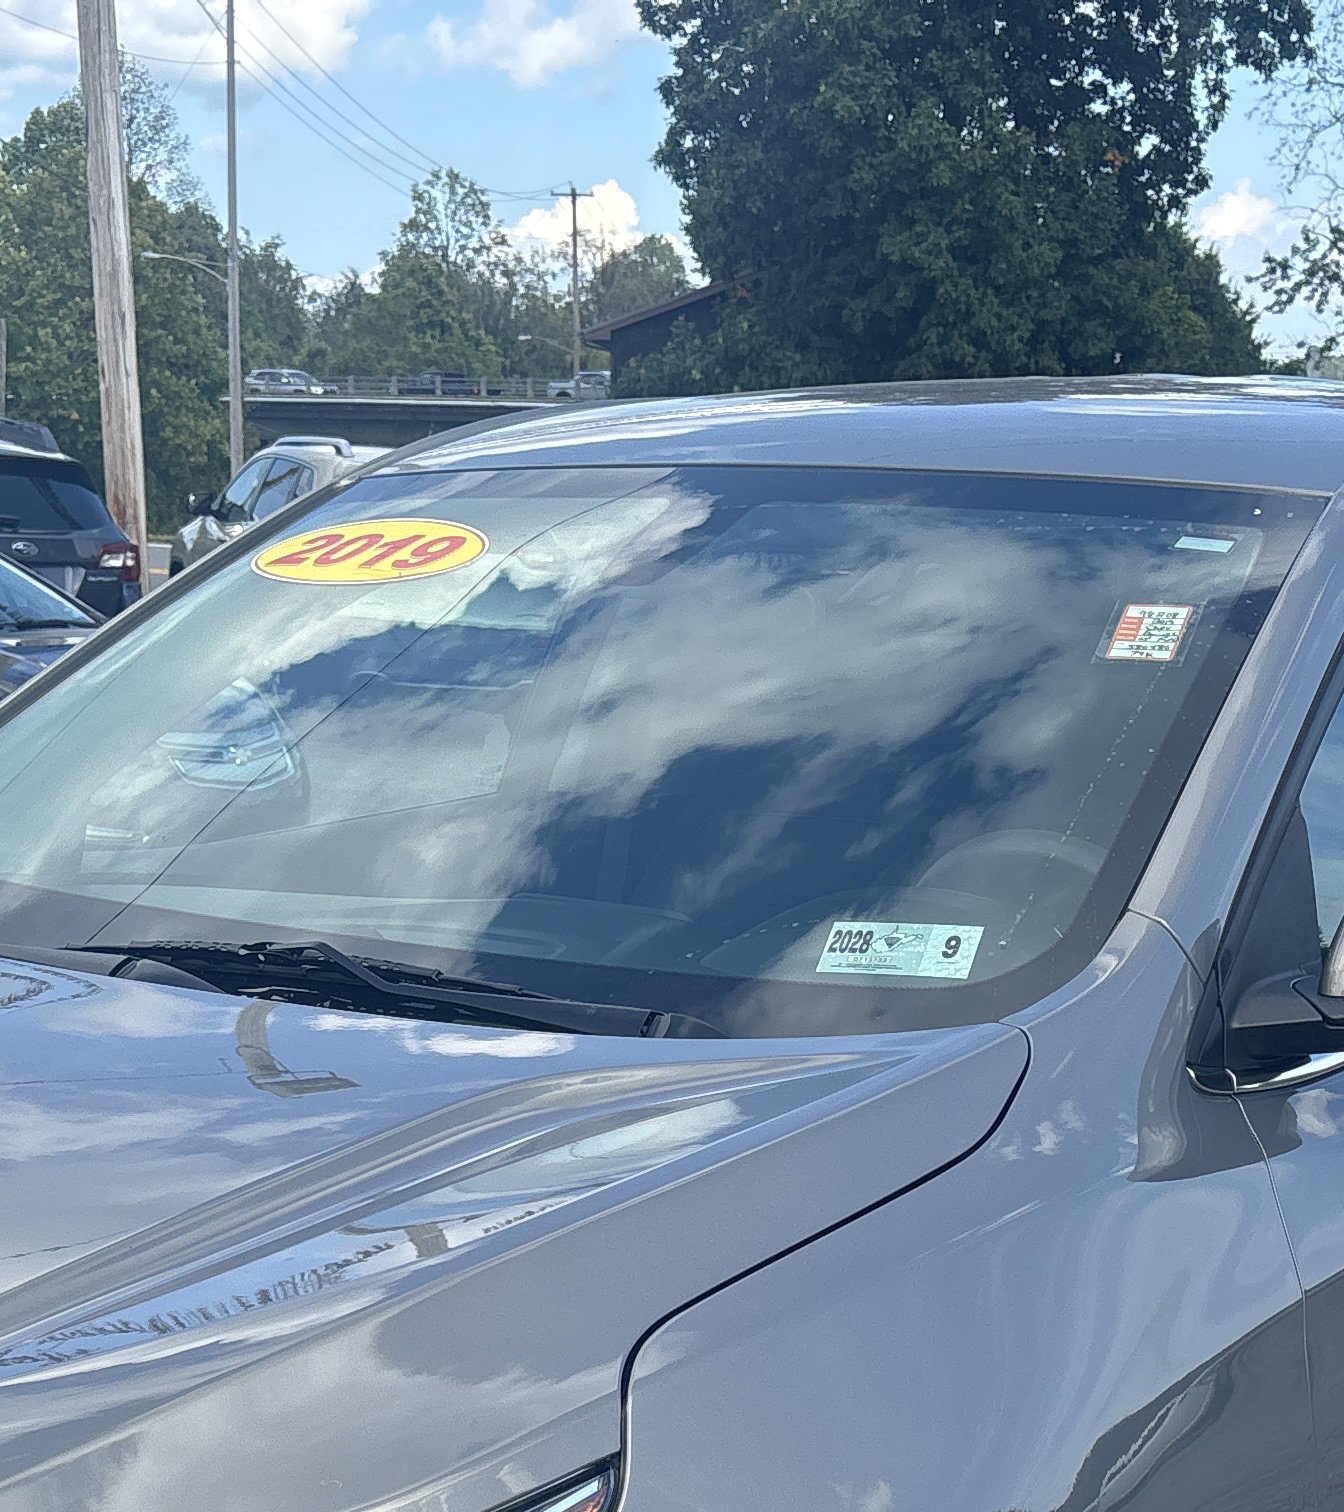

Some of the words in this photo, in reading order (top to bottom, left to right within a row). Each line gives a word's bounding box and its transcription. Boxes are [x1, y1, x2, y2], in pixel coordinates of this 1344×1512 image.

[265, 532, 469, 570] 2019
[826, 929, 875, 954] 2028
[941, 935, 962, 959] 9
